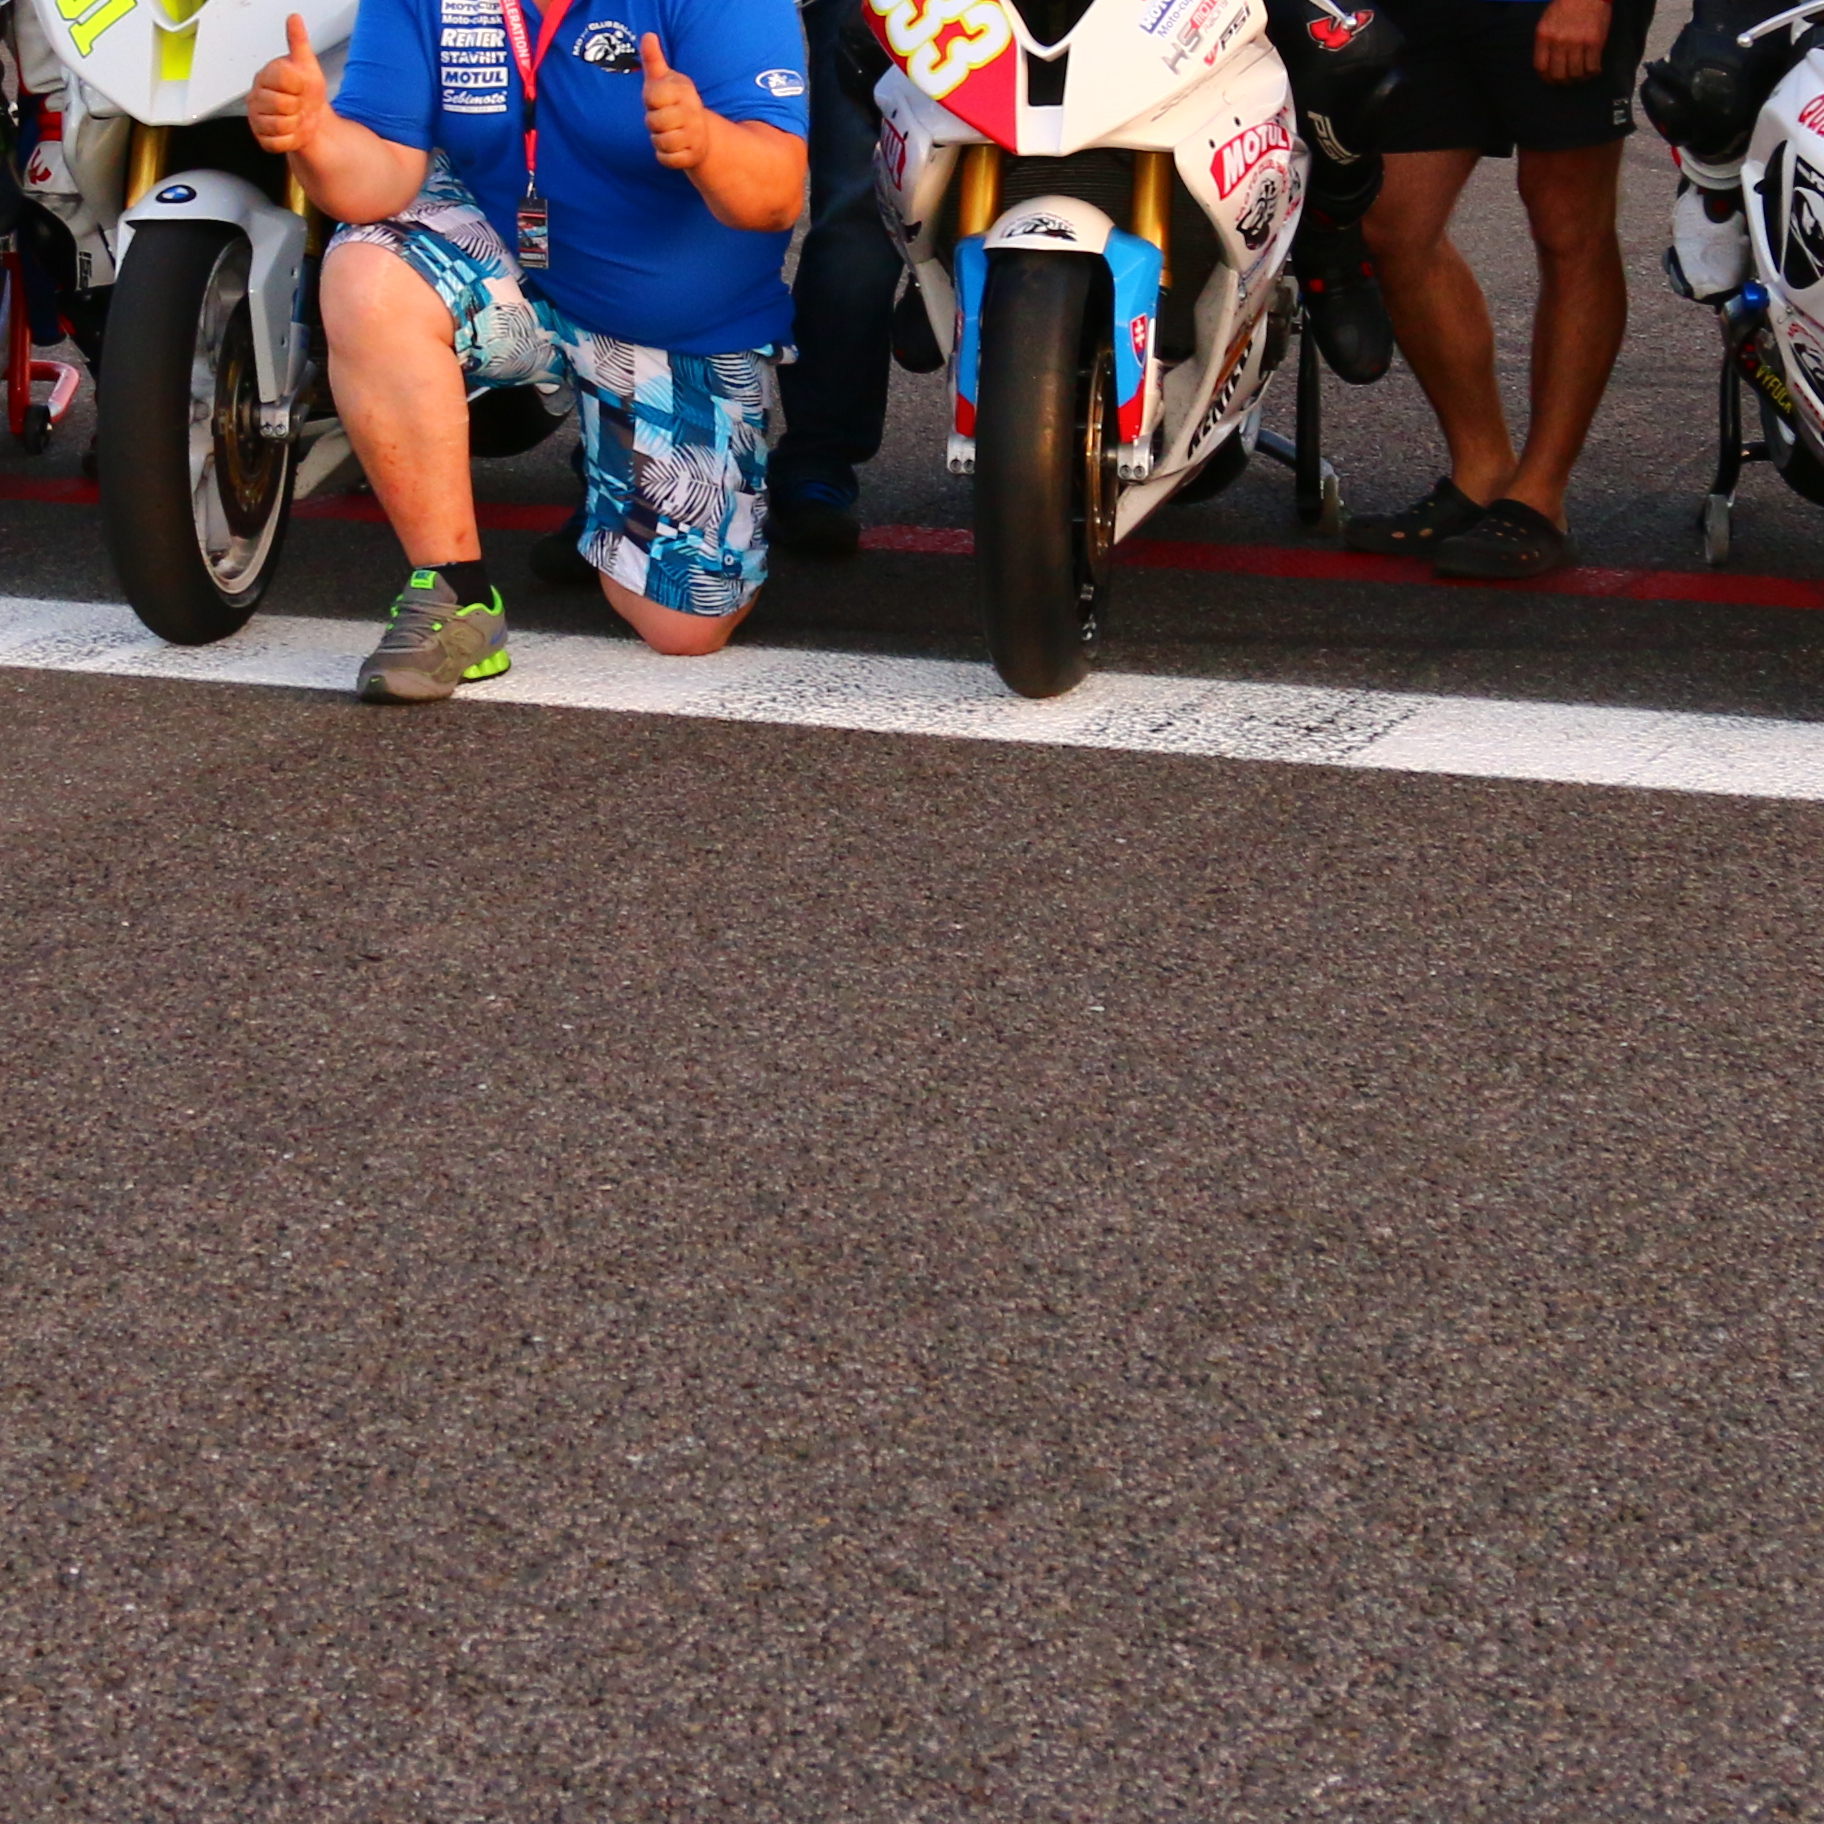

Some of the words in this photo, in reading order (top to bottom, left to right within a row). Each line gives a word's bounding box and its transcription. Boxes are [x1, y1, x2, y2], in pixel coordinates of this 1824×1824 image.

[445, 1, 500, 12] MOTOCUP
[440, 28, 506, 48] RENTER
[1160, 21, 1205, 75] HS
[440, 50, 508, 64] STAVHIT
[444, 69, 502, 84] MOTUL
[442, 89, 508, 105] Sebimoto
[1221, 124, 1289, 195] MOTUL
